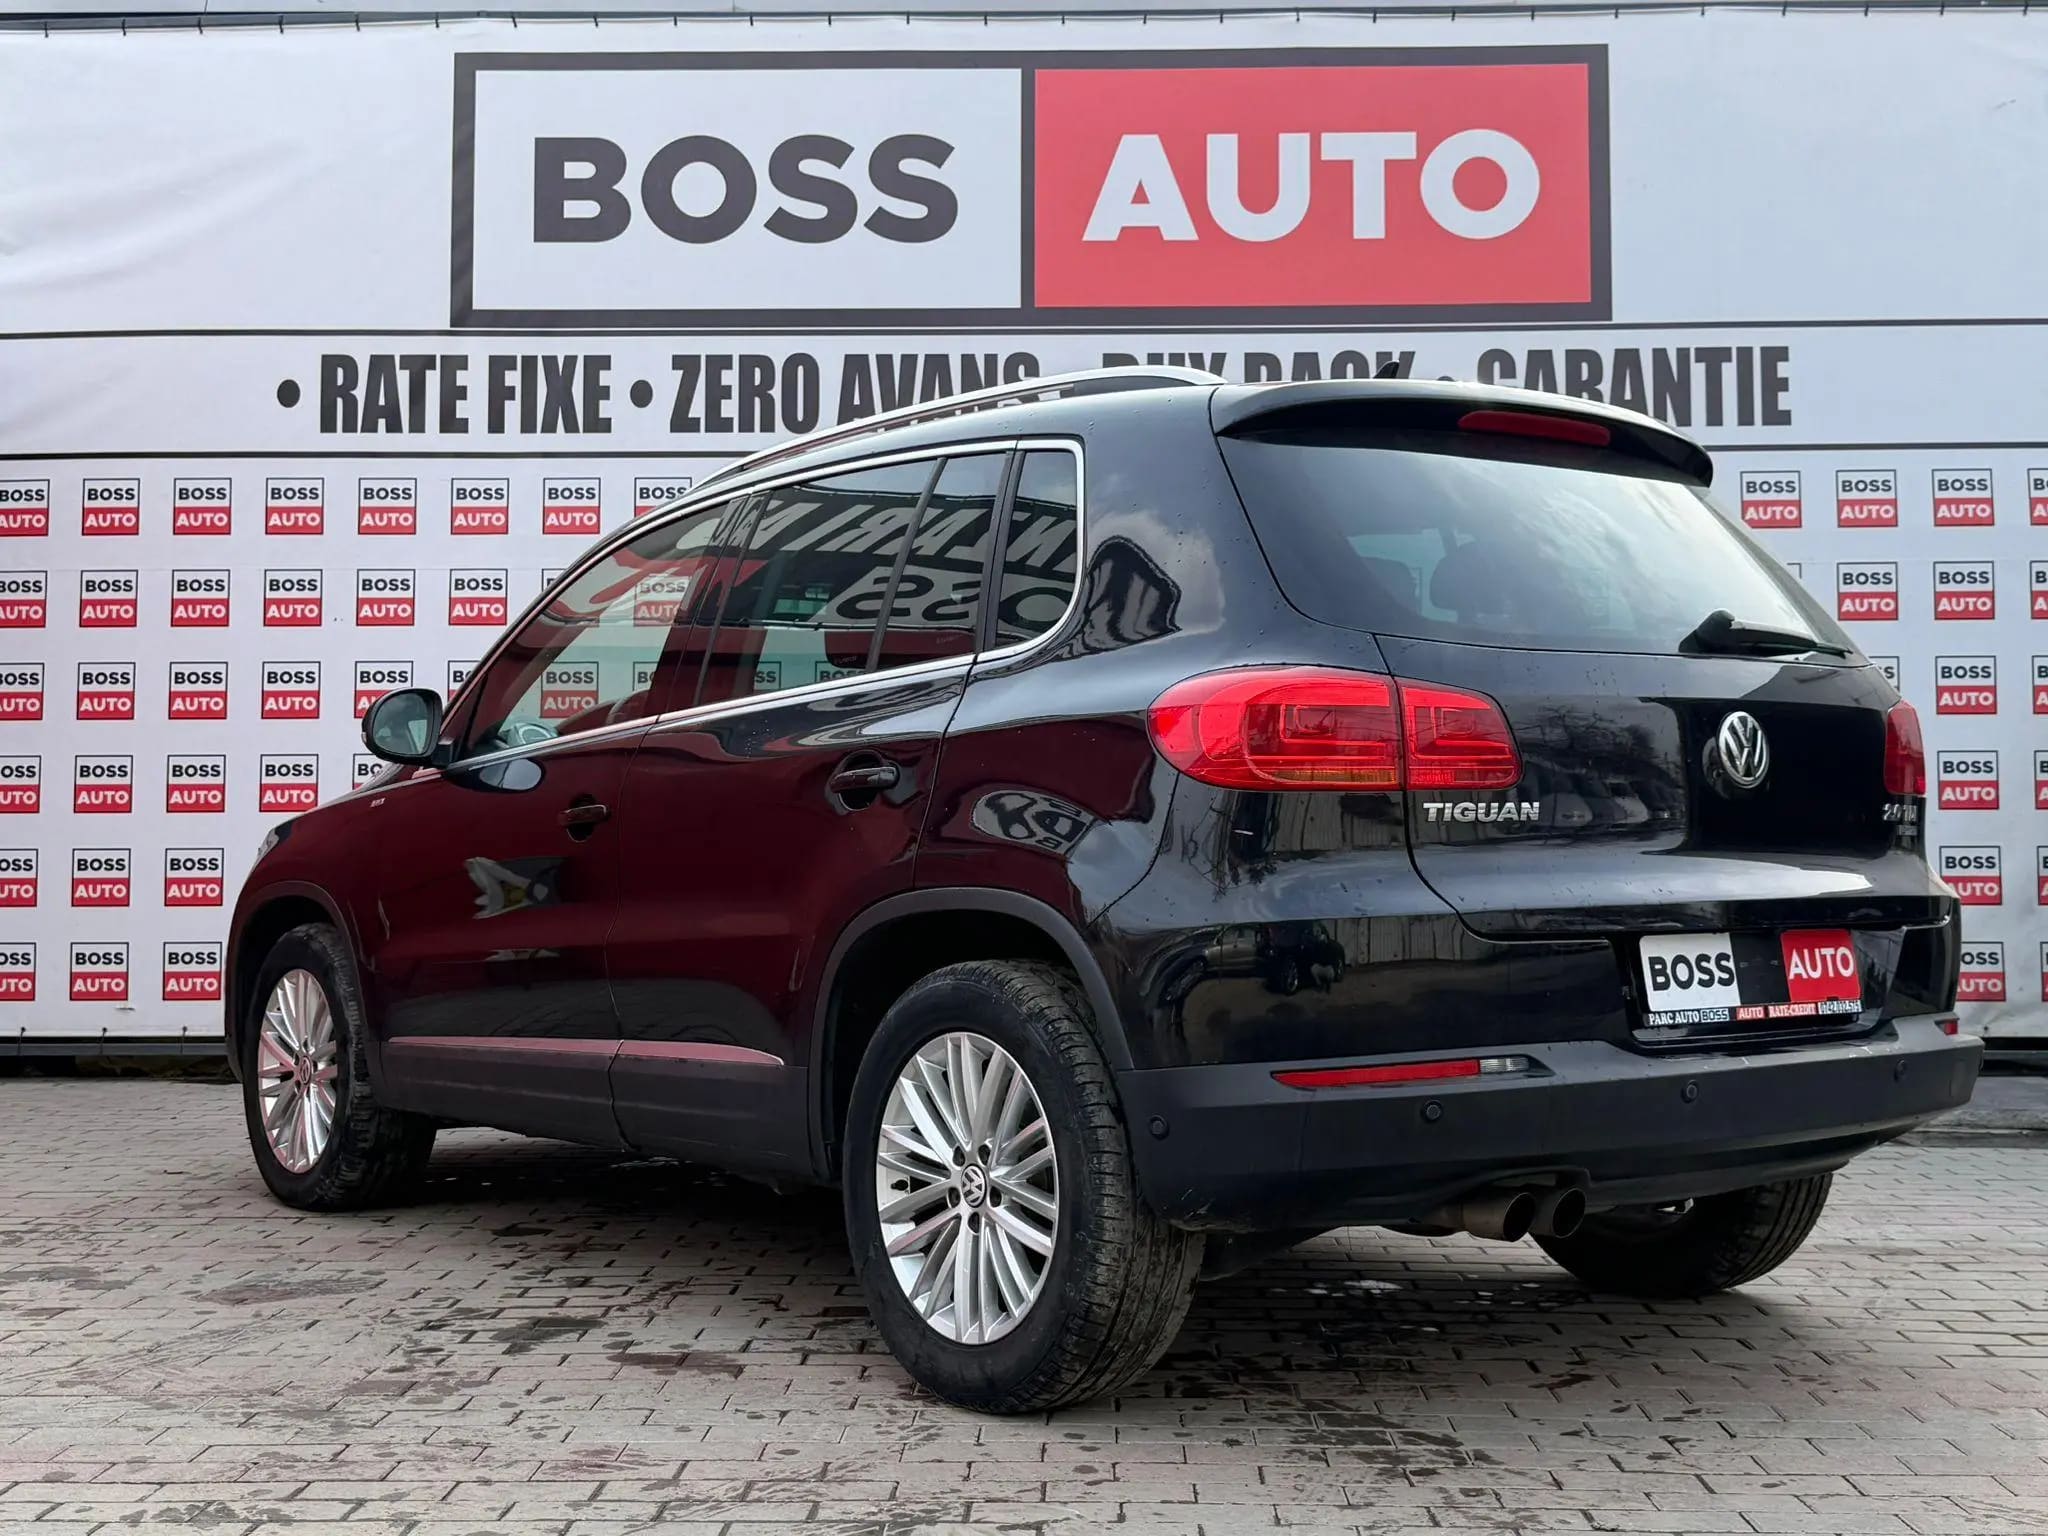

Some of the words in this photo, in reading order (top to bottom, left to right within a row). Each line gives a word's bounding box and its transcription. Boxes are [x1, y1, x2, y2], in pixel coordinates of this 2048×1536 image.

[533, 133, 958, 243] BOSS
[1082, 128, 1541, 242] AUTO
[320, 353, 469, 434] RATE
[487, 353, 612, 434] FIXE
[669, 352, 820, 435] ZERO
[1745, 481, 1796, 494] BOSS
[1842, 480, 1891, 493] BOSS
[1938, 479, 1990, 492] BOSS
[88, 488, 135, 500] BOSS
[179, 488, 226, 500] BOSS
[271, 488, 319, 500] BOSS
[364, 488, 412, 500] BOSS
[456, 488, 504, 500] BOSS
[549, 488, 595, 499] BOSS
[1745, 506, 1798, 520] AUTO
[1842, 505, 1894, 518] AUTO
[1938, 504, 1991, 517] AUTO
[86, 514, 136, 527] AUTO
[177, 513, 227, 526] AUTO
[269, 513, 320, 526] AUTO
[362, 513, 413, 526] AUTO
[454, 513, 505, 526] AUTO
[546, 513, 597, 525] AUTO
[455, 578, 503, 590] BOSS
[1843, 572, 1892, 585] BOSS
[1939, 571, 1989, 584] BOSS
[86, 580, 133, 592] BOSS
[177, 579, 225, 591] BOSS
[270, 579, 317, 591] BOSS
[362, 579, 410, 591] BOSS
[640, 582, 686, 593] BOSS
[267, 605, 318, 617] AUTO
[360, 604, 411, 617] AUTO
[452, 604, 504, 616] AUTO
[1842, 599, 1895, 611] AUTO
[1938, 598, 1991, 611] AUTO
[83, 605, 133, 618] AUTO
[175, 605, 226, 618] AUTO
[83, 672, 130, 684] BOSS
[175, 672, 222, 684] BOSS
[267, 671, 315, 683] BOSS
[360, 671, 409, 683] BOSS
[546, 671, 594, 684] BOSS
[1941, 666, 1991, 678] BOSS
[0, 673, 39, 685] OSS
[0, 698, 40, 711] UTO
[81, 698, 131, 711] AUTO
[172, 698, 224, 710] AUTO
[265, 697, 316, 710] AUTO
[544, 697, 595, 710] AUTO
[1940, 692, 1993, 705] AUTO
[1, 766, 36, 778] OSS
[80, 765, 127, 777] BOSS
[172, 765, 220, 777] BOSS
[265, 764, 313, 776] BOSS
[1943, 760, 1994, 774] BOSS
[0, 791, 36, 804] UTO
[78, 791, 129, 804] AUTO
[170, 791, 222, 803] AUTO
[263, 790, 315, 803] AUTO
[1941, 786, 1996, 801] AUTO
[1423, 802, 1540, 822] TIGUAN
[0, 859, 33, 871] OSS
[78, 858, 125, 871] BOSS
[170, 858, 219, 871] BOSS
[1945, 856, 1996, 869] BOSS
[0, 885, 34, 898] UTO
[75, 885, 126, 897] AUTO
[168, 884, 220, 897] AUTO
[76, 952, 124, 965] BOSS
[168, 952, 216, 964] BOSS
[1789, 946, 1854, 980] AUTO
[1961, 952, 2000, 965] OSS
[1648, 952, 1736, 992] BOSS
[74, 979, 125, 991] AUTO
[167, 978, 218, 991] AUTO
[1957, 979, 2003, 992] UTO
[1649, 1012, 1674, 1026] PARC
[1675, 1011, 1699, 1024] AUTO
[1701, 1009, 1729, 1022] BOSS
[1738, 1006, 1763, 1019] AUTO
